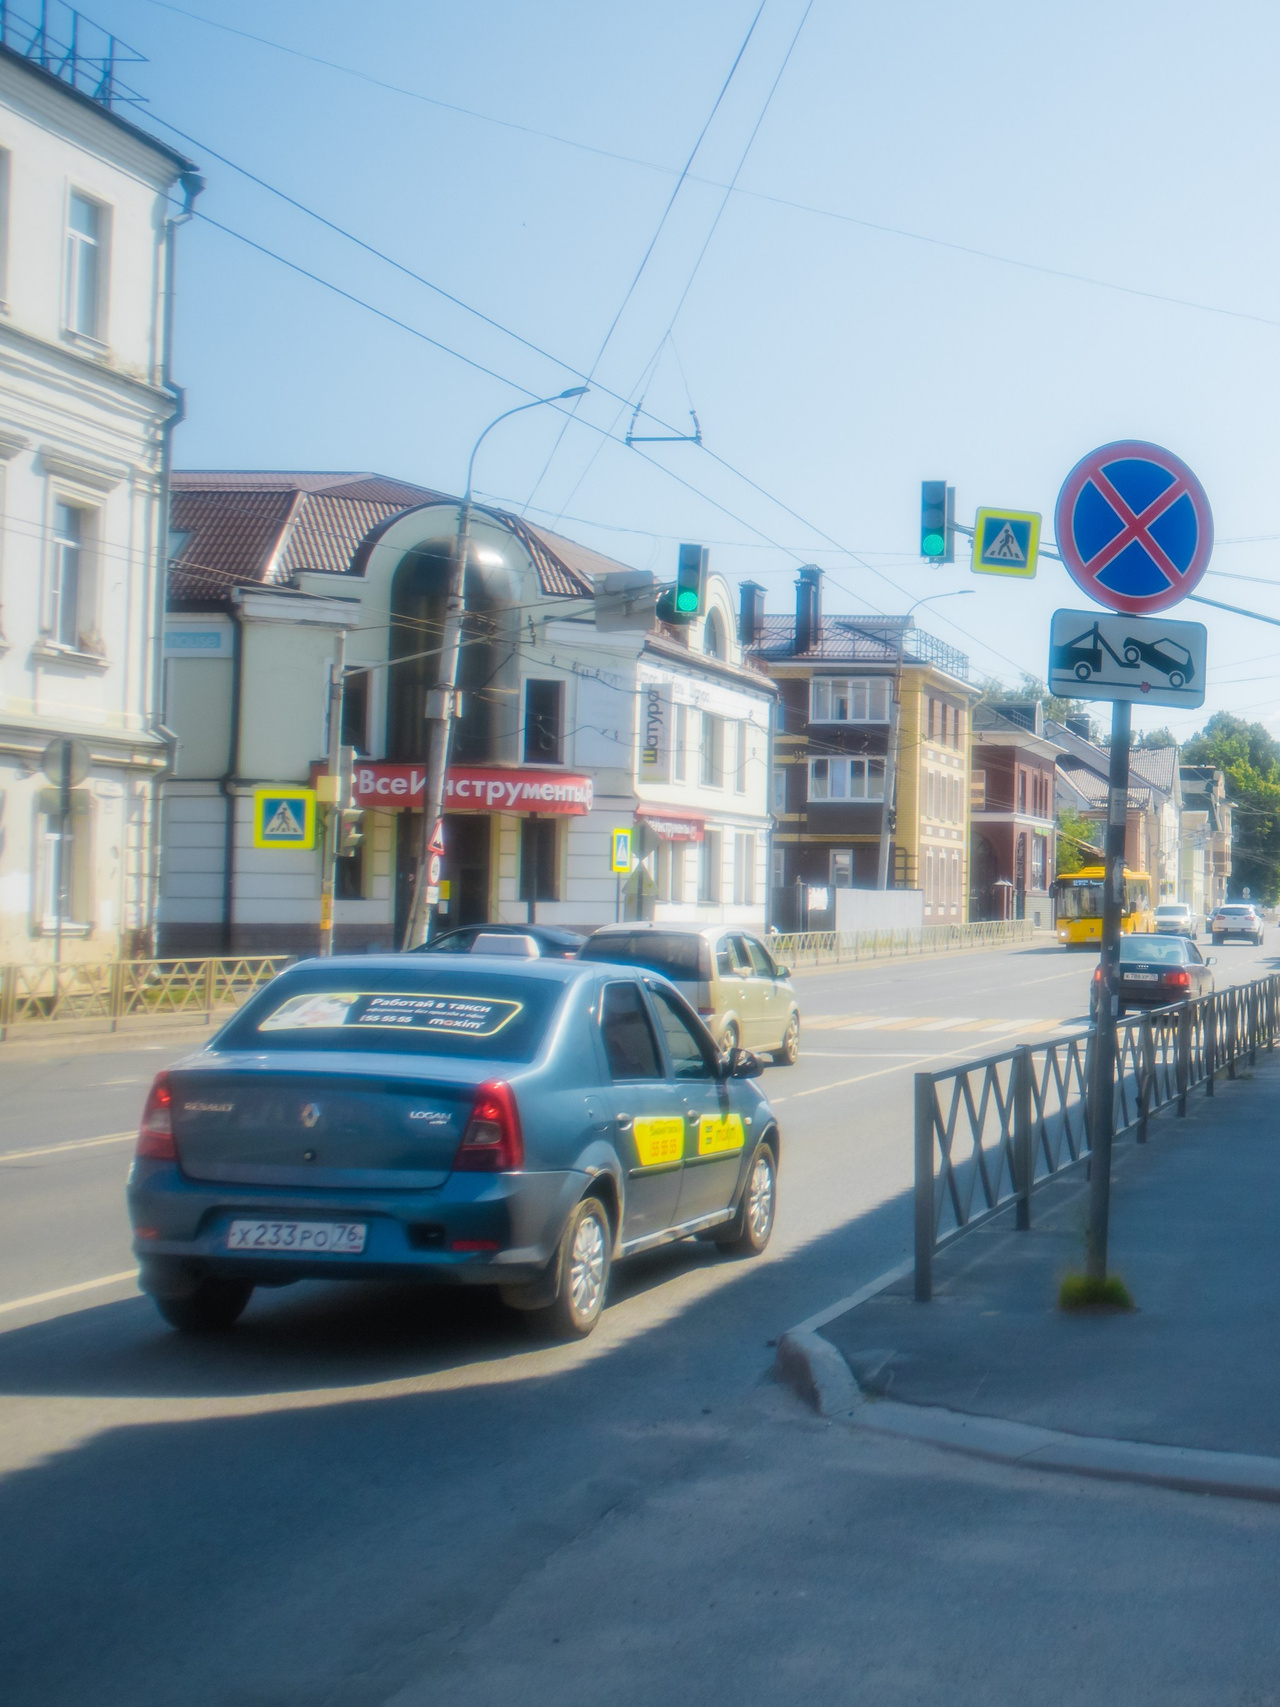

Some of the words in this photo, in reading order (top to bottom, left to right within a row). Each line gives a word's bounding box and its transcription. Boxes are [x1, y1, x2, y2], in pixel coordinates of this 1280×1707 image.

[371, 998, 435, 1008] Работай
[449, 1003, 493, 1013] такси
[428, 1018, 483, 1029] maxim
[409, 1111, 451, 1120] LOGAN
